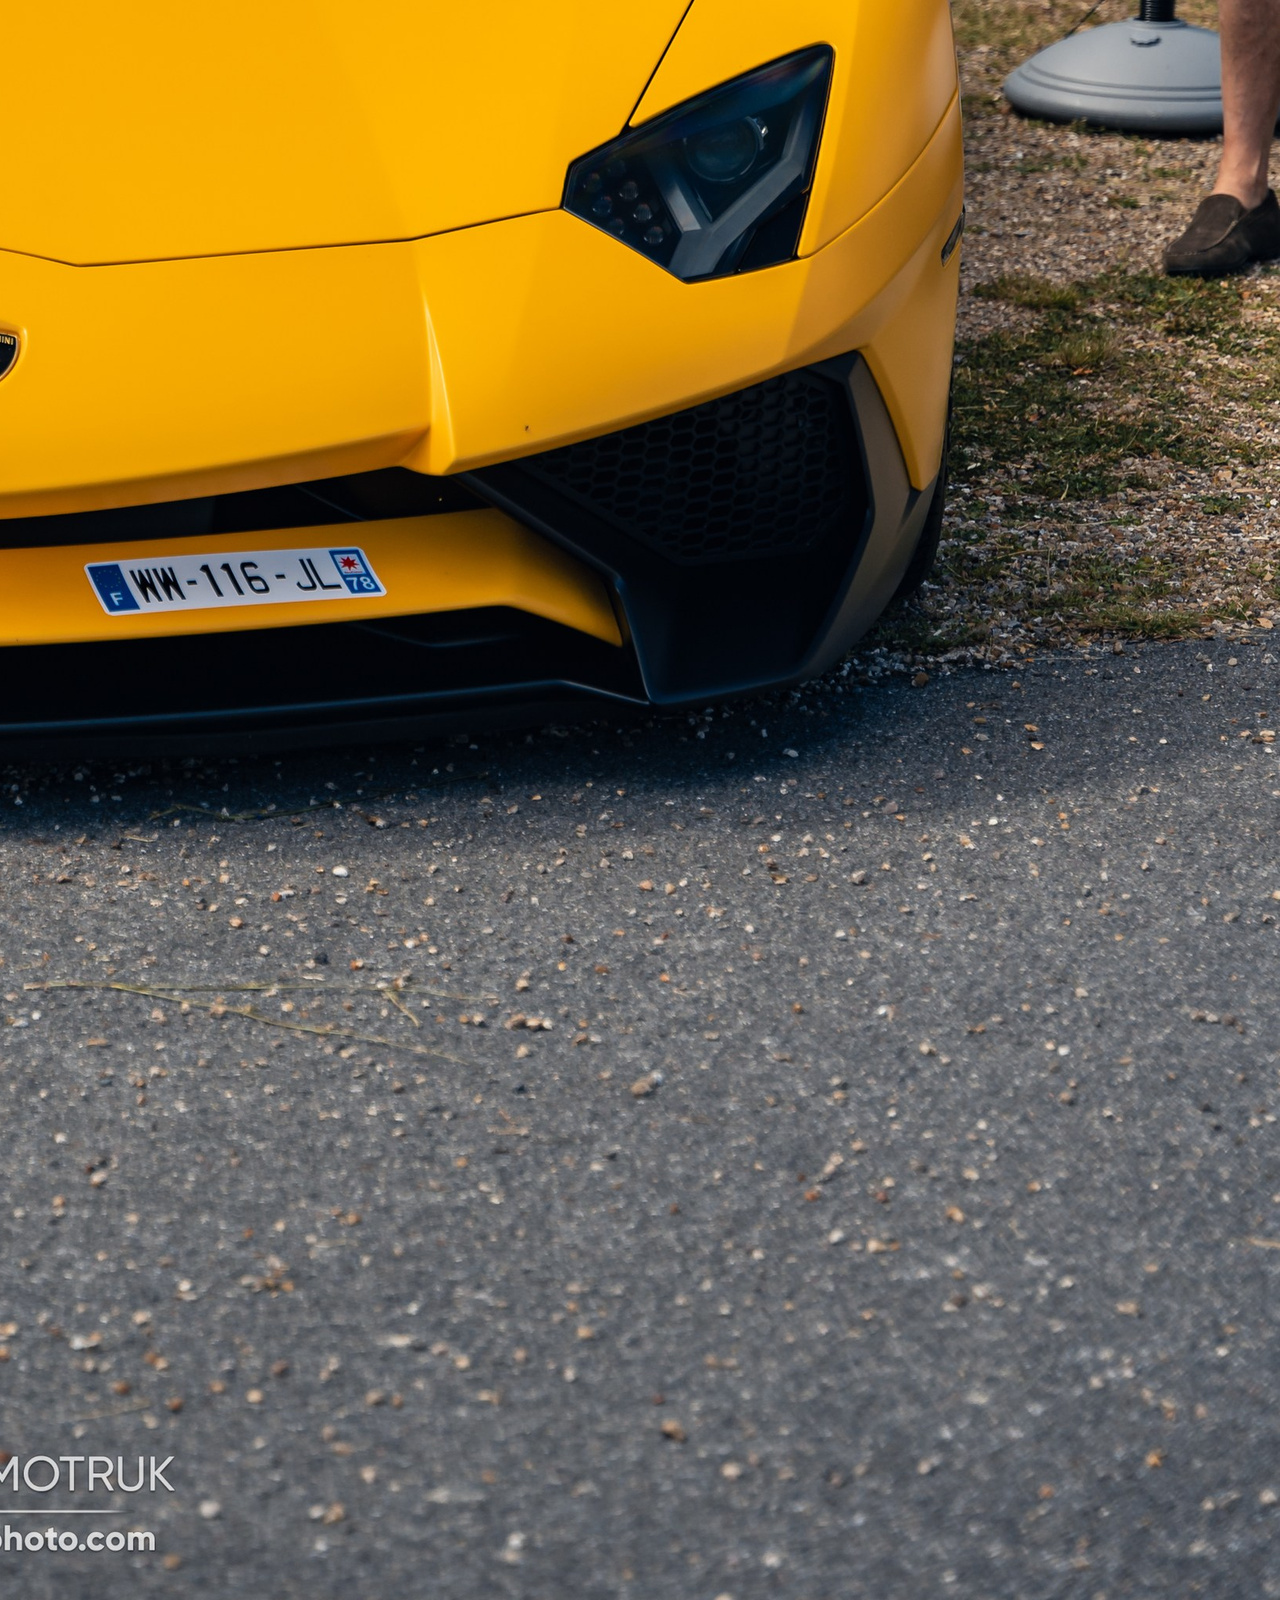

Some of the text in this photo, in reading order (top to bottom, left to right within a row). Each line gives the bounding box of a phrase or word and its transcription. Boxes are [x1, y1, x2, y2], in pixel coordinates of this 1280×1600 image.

[129, 558, 342, 604] WW-116-JL
[345, 576, 376, 591] 78
[110, 592, 124, 606] F
